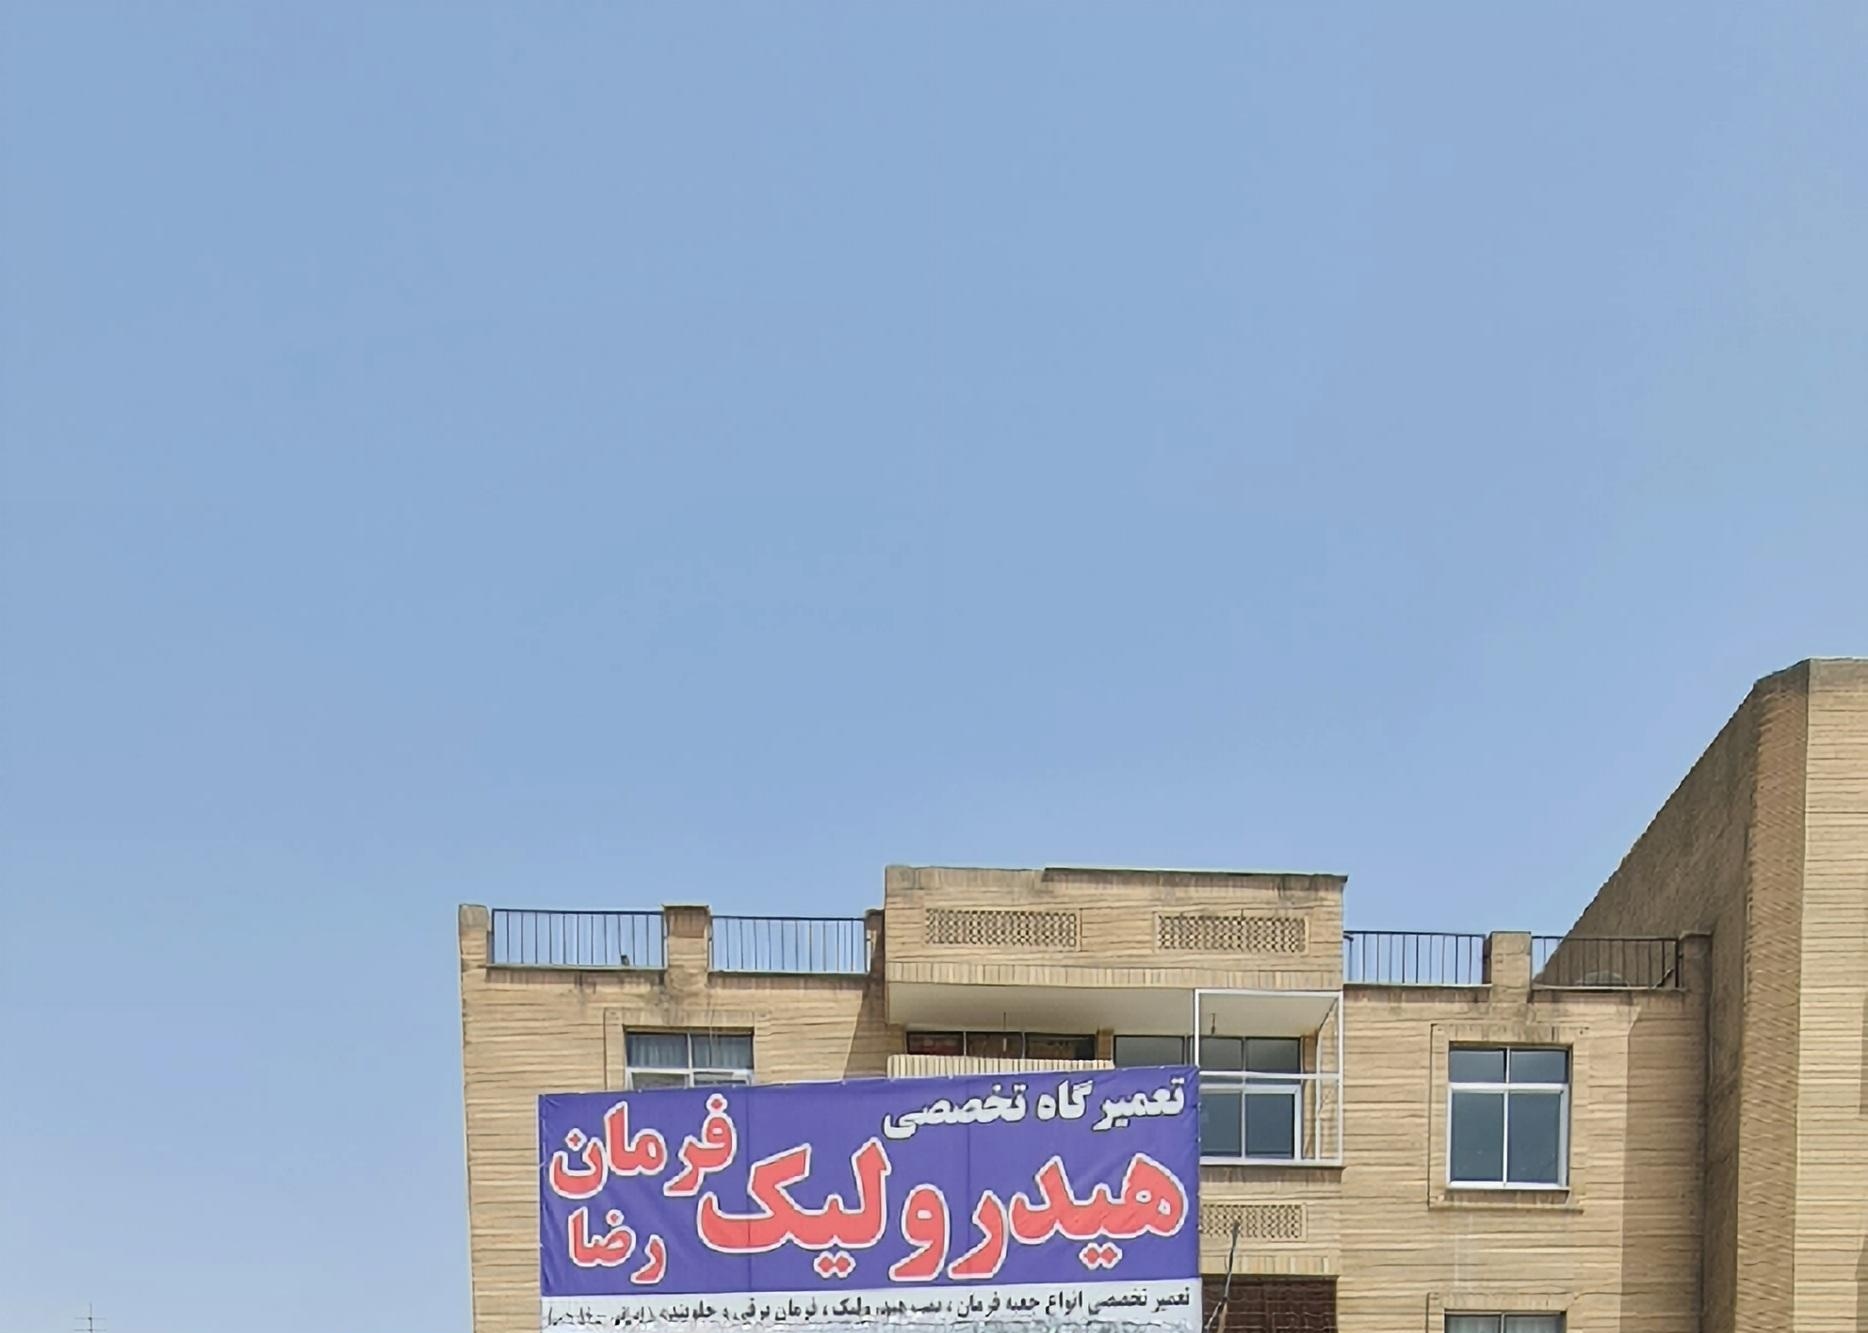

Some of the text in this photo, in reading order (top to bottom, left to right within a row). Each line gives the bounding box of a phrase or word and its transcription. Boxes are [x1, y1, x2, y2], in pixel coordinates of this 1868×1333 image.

[883, 1083, 1027, 1139] تخصصی
[550, 1093, 1188, 1281] هیدرولیک فرمان
[568, 1206, 666, 1283] رضا
[1045, 1290, 1083, 1316] انواع
[1088, 1288, 1147, 1315] تخصصی
[1151, 1287, 1190, 1313] تعمیر
